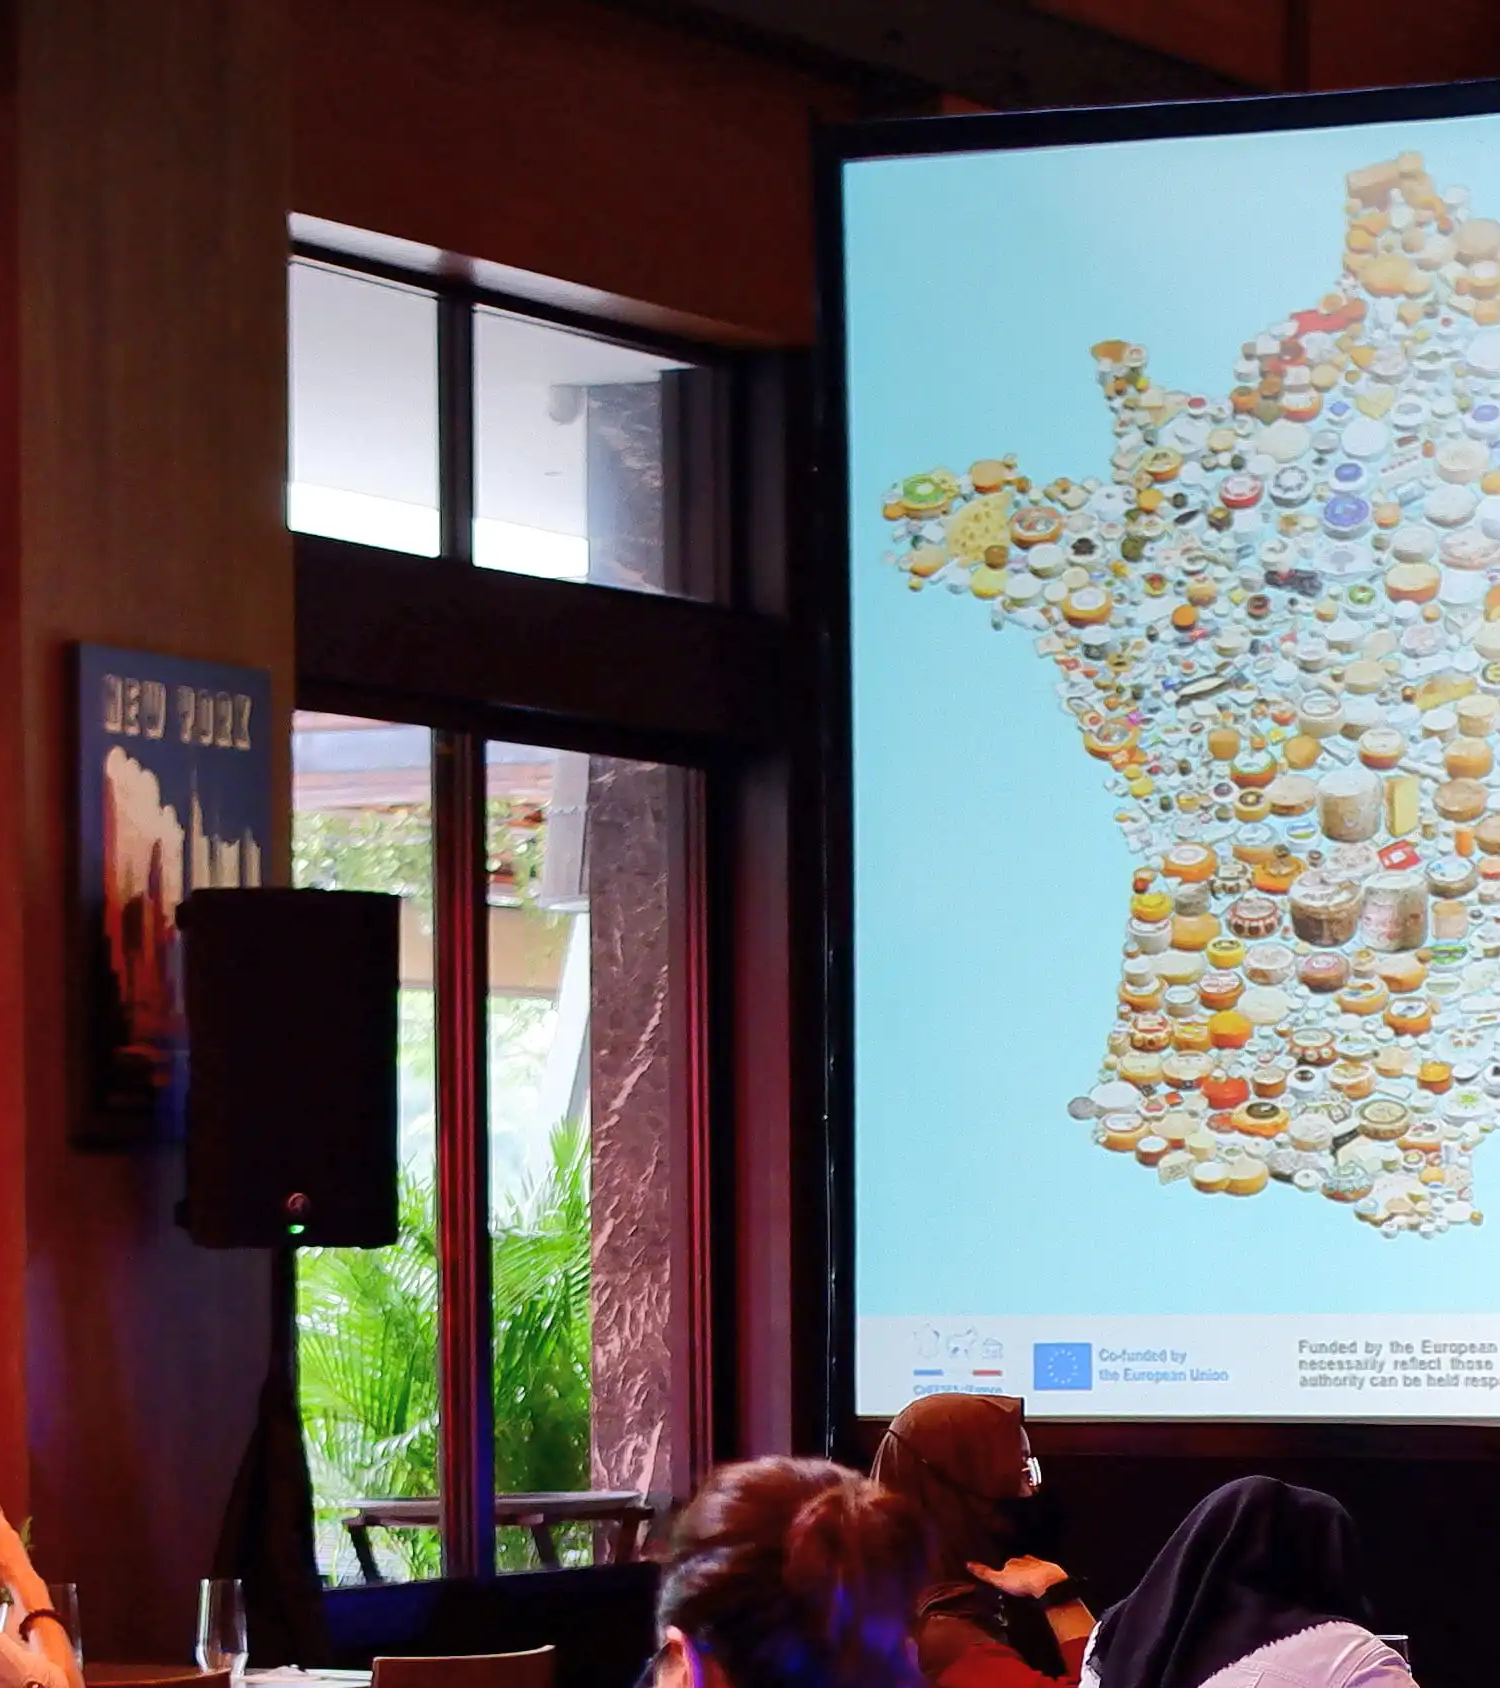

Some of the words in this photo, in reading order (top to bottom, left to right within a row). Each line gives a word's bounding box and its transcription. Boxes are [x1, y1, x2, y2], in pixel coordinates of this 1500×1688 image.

[102, 673, 166, 739] NEW
[177, 685, 252, 751] YORK
[1098, 1348, 1167, 1362] Co-funded
[1170, 1349, 1187, 1365] by
[1298, 1339, 1357, 1354] Funded
[1364, 1340, 1383, 1357] by
[1390, 1340, 1414, 1354] the
[1421, 1339, 1498, 1357] European
[1298, 1356, 1384, 1373] necessarily
[1393, 1356, 1441, 1370] reflect
[1450, 1356, 1493, 1370] those
[1098, 1368, 1119, 1381] the
[1123, 1367, 1187, 1384] European
[1190, 1368, 1229, 1382] Union
[1299, 1373, 1365, 1390] authority
[1370, 1376, 1398, 1387] can
[1403, 1374, 1422, 1387] be
[1427, 1373, 1460, 1387] held
